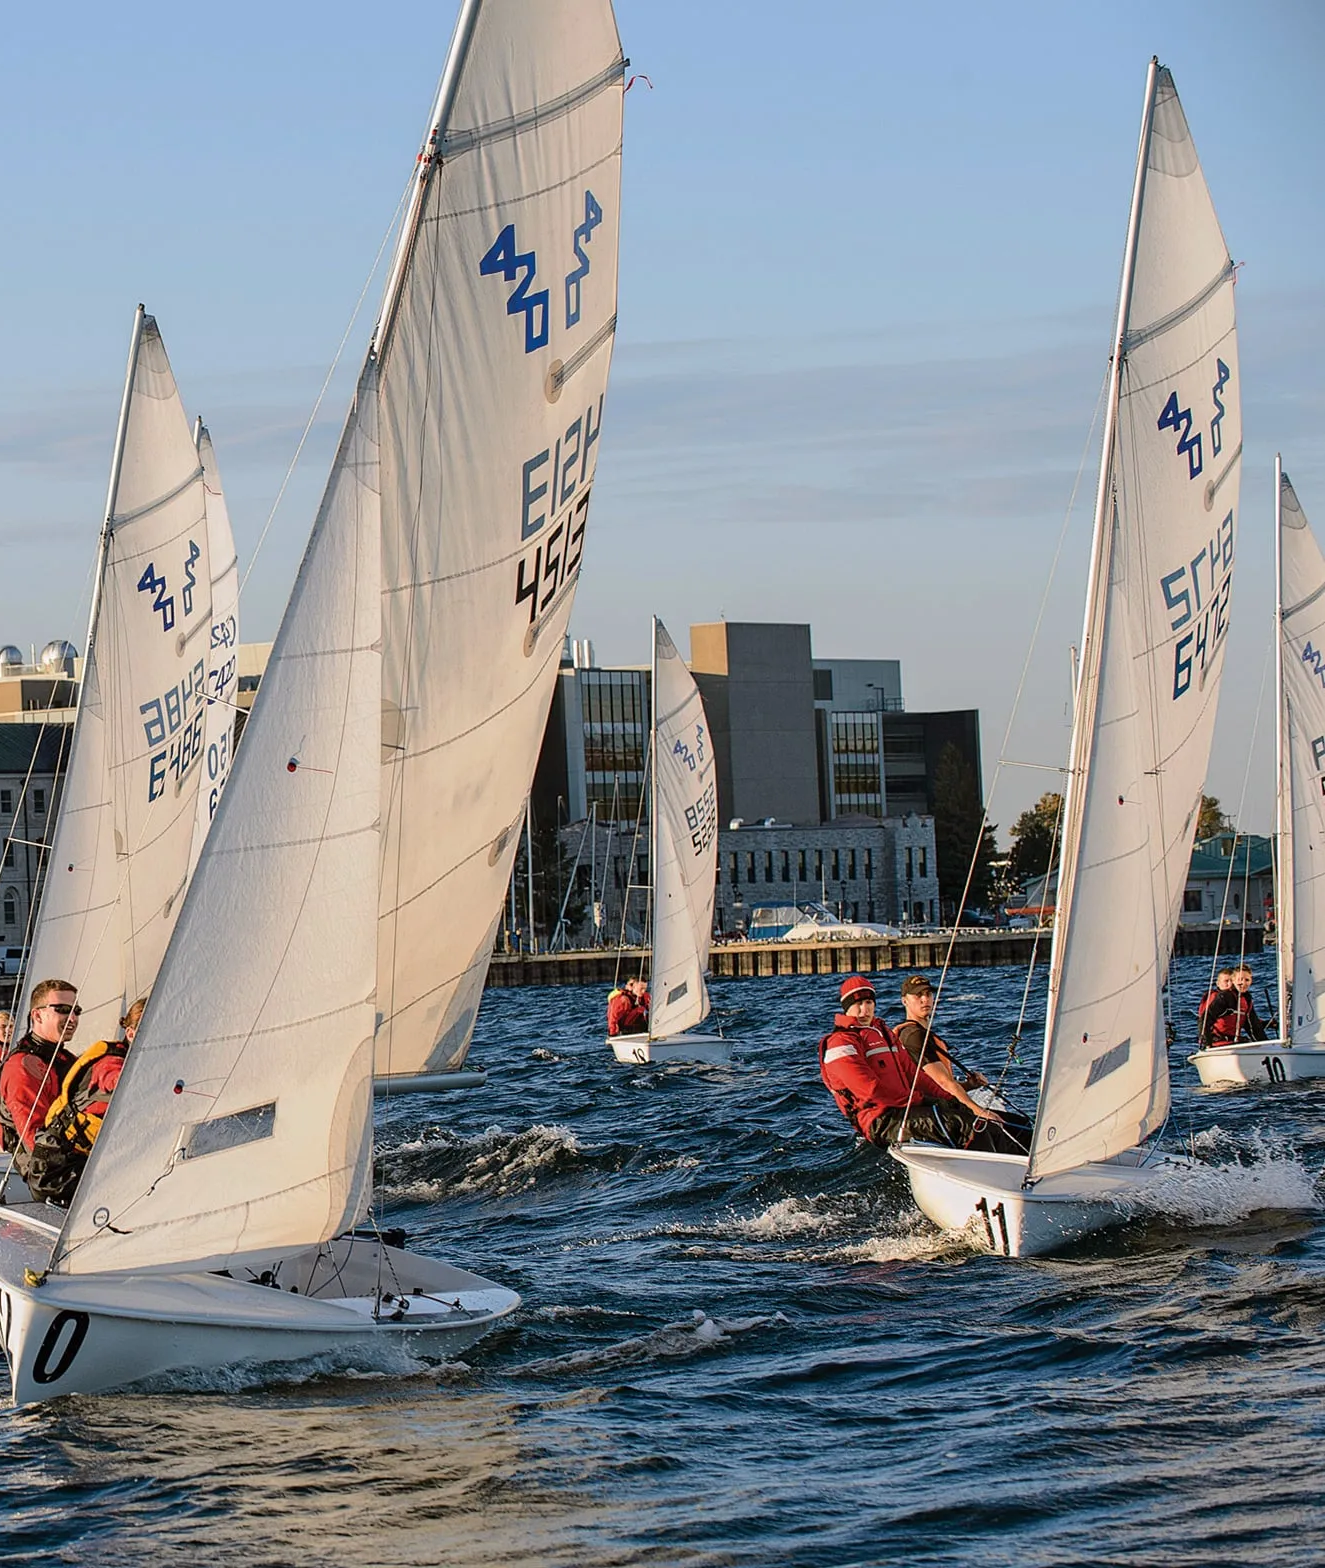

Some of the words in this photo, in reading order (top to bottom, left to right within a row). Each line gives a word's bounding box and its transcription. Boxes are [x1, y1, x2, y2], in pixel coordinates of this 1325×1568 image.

[479, 223, 550, 354] 420
[1157, 391, 1203, 481] 420
[137, 562, 175, 633] 420
[1172, 570, 1232, 701] 6472
[148, 706, 205, 803] 6486
[673, 739, 697, 771] 420
[1261, 1056, 1286, 1083] 10
[975, 1196, 1010, 1256] 11
[32, 1309, 90, 1384] 0
